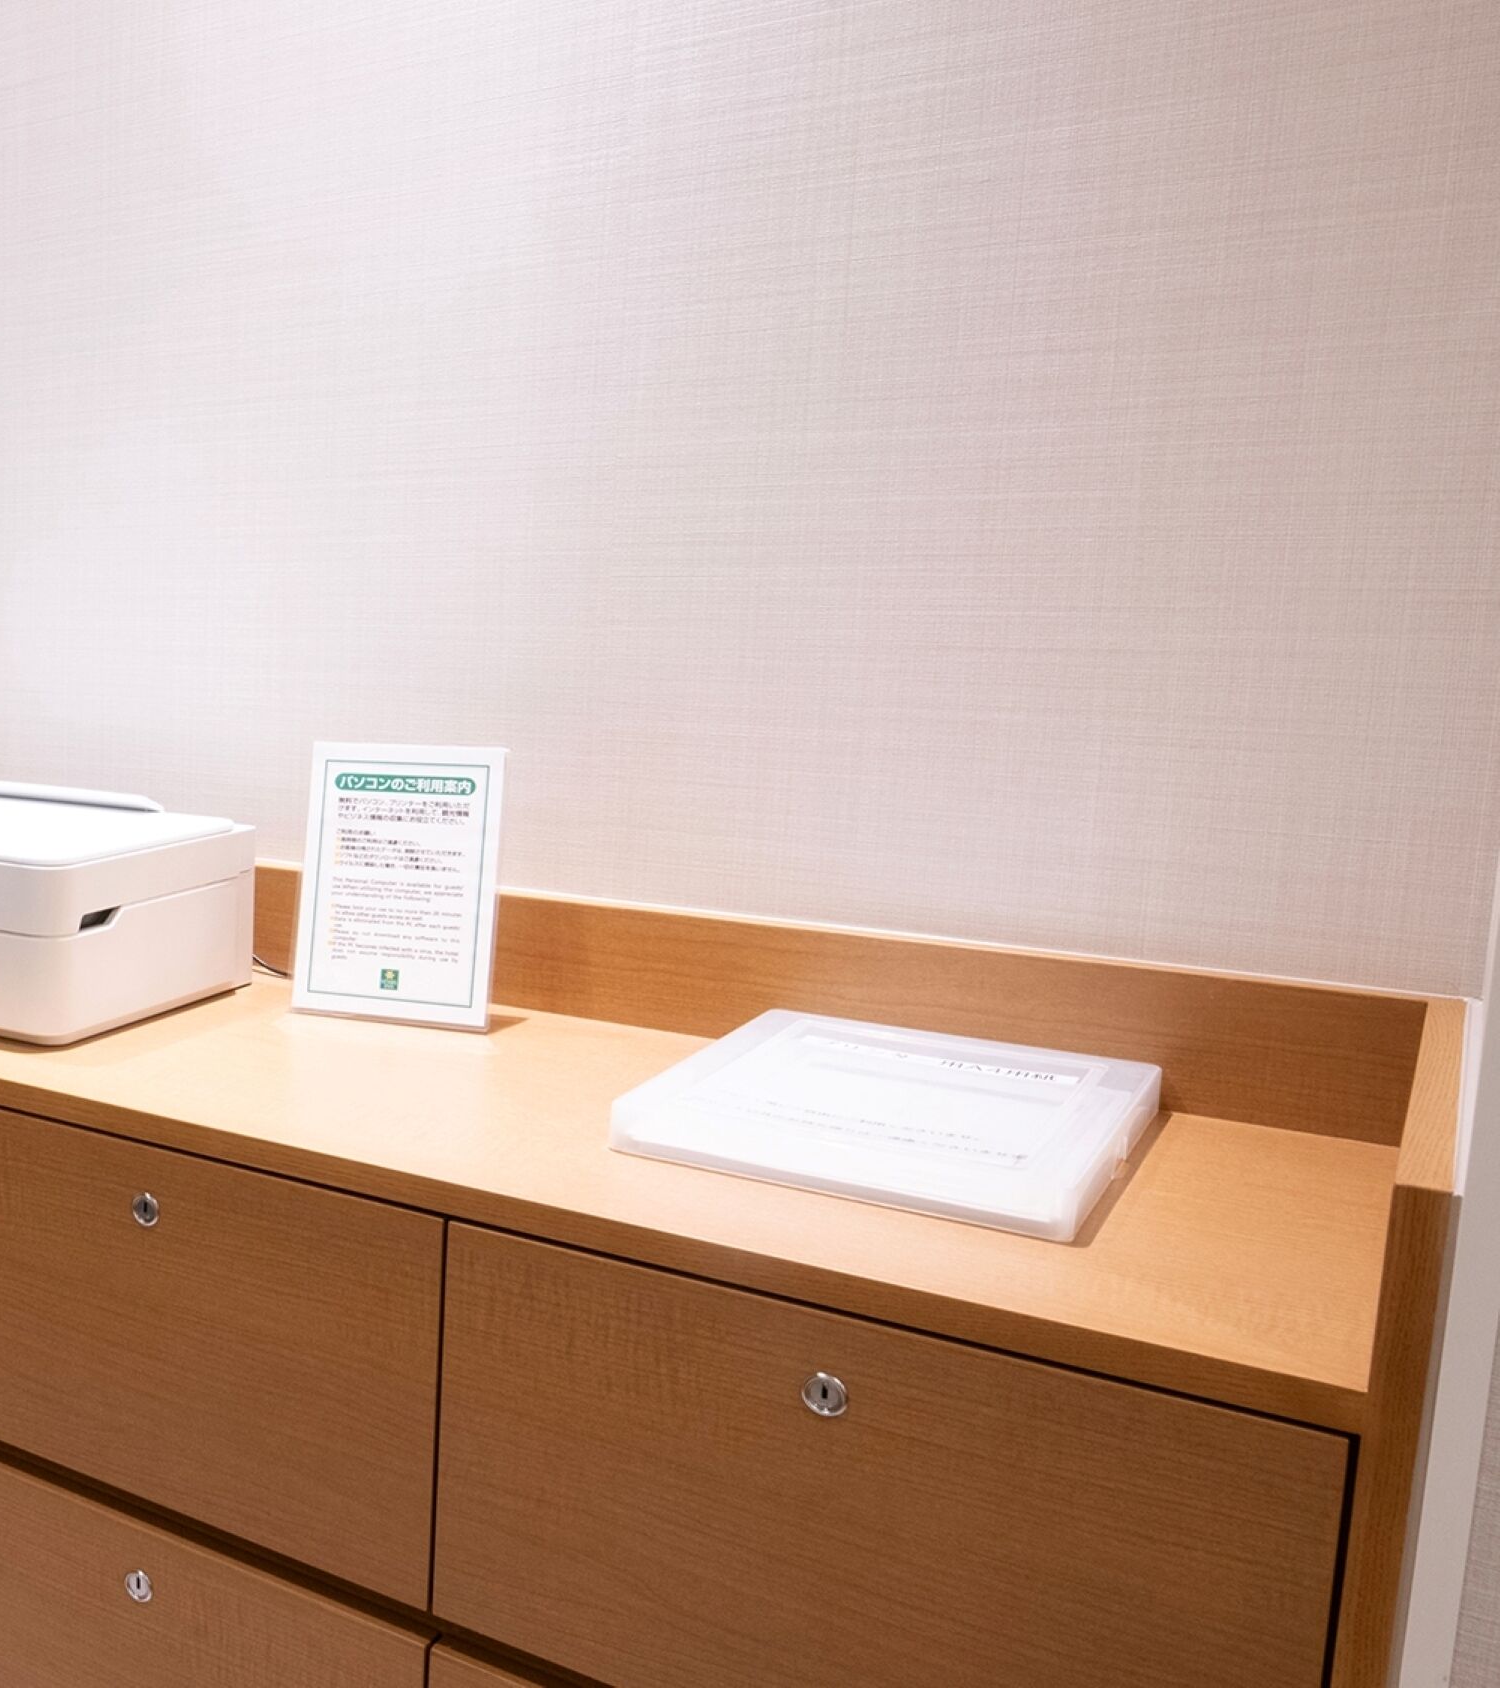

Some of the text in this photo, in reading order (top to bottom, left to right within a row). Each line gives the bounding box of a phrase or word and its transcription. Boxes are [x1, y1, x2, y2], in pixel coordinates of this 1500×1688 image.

[339, 775, 471, 793] パソコンのご利用案内
